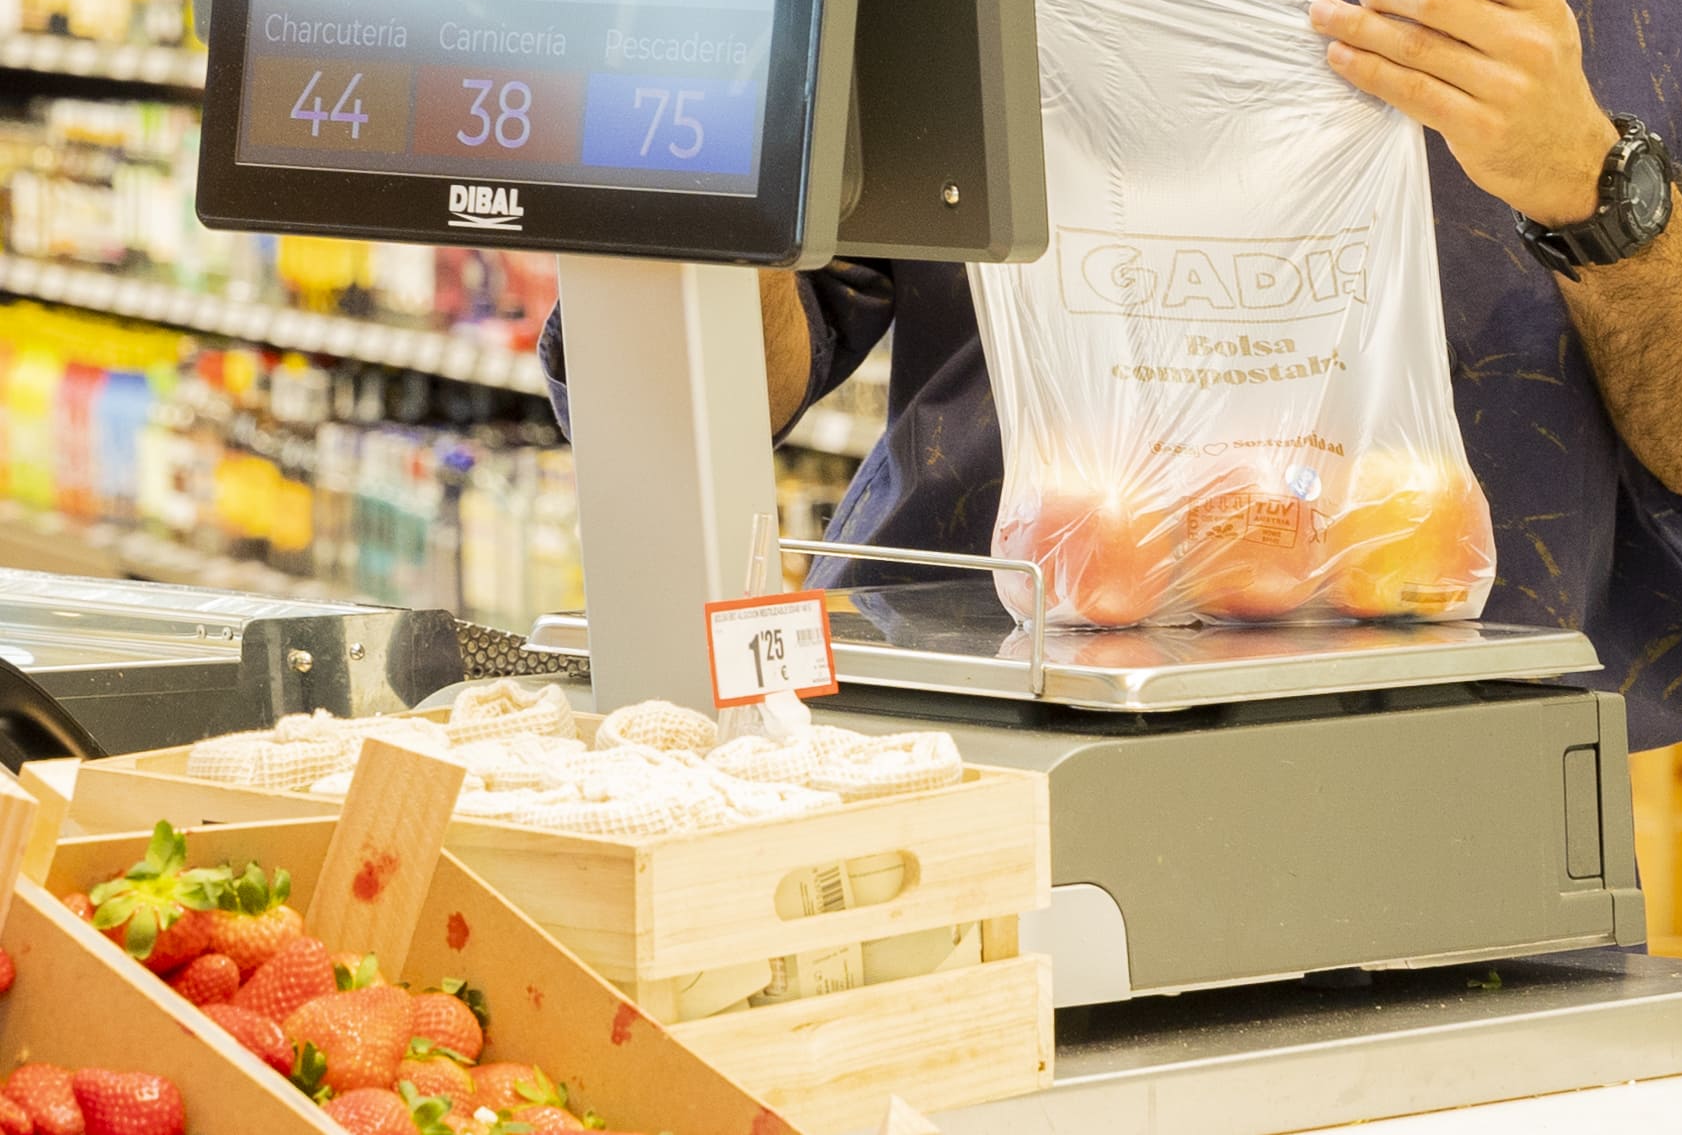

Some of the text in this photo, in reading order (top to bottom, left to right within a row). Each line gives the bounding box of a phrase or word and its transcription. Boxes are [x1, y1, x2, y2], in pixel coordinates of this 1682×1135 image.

[264, 13, 408, 49] Charcutería
[439, 21, 567, 57] Carnicería
[606, 29, 748, 65] Pescadería
[290, 70, 370, 140] 44
[457, 78, 533, 150] 38
[633, 87, 706, 160] 75
[449, 184, 524, 218] DIBAL
[1185, 334, 1297, 357] Bolsa
